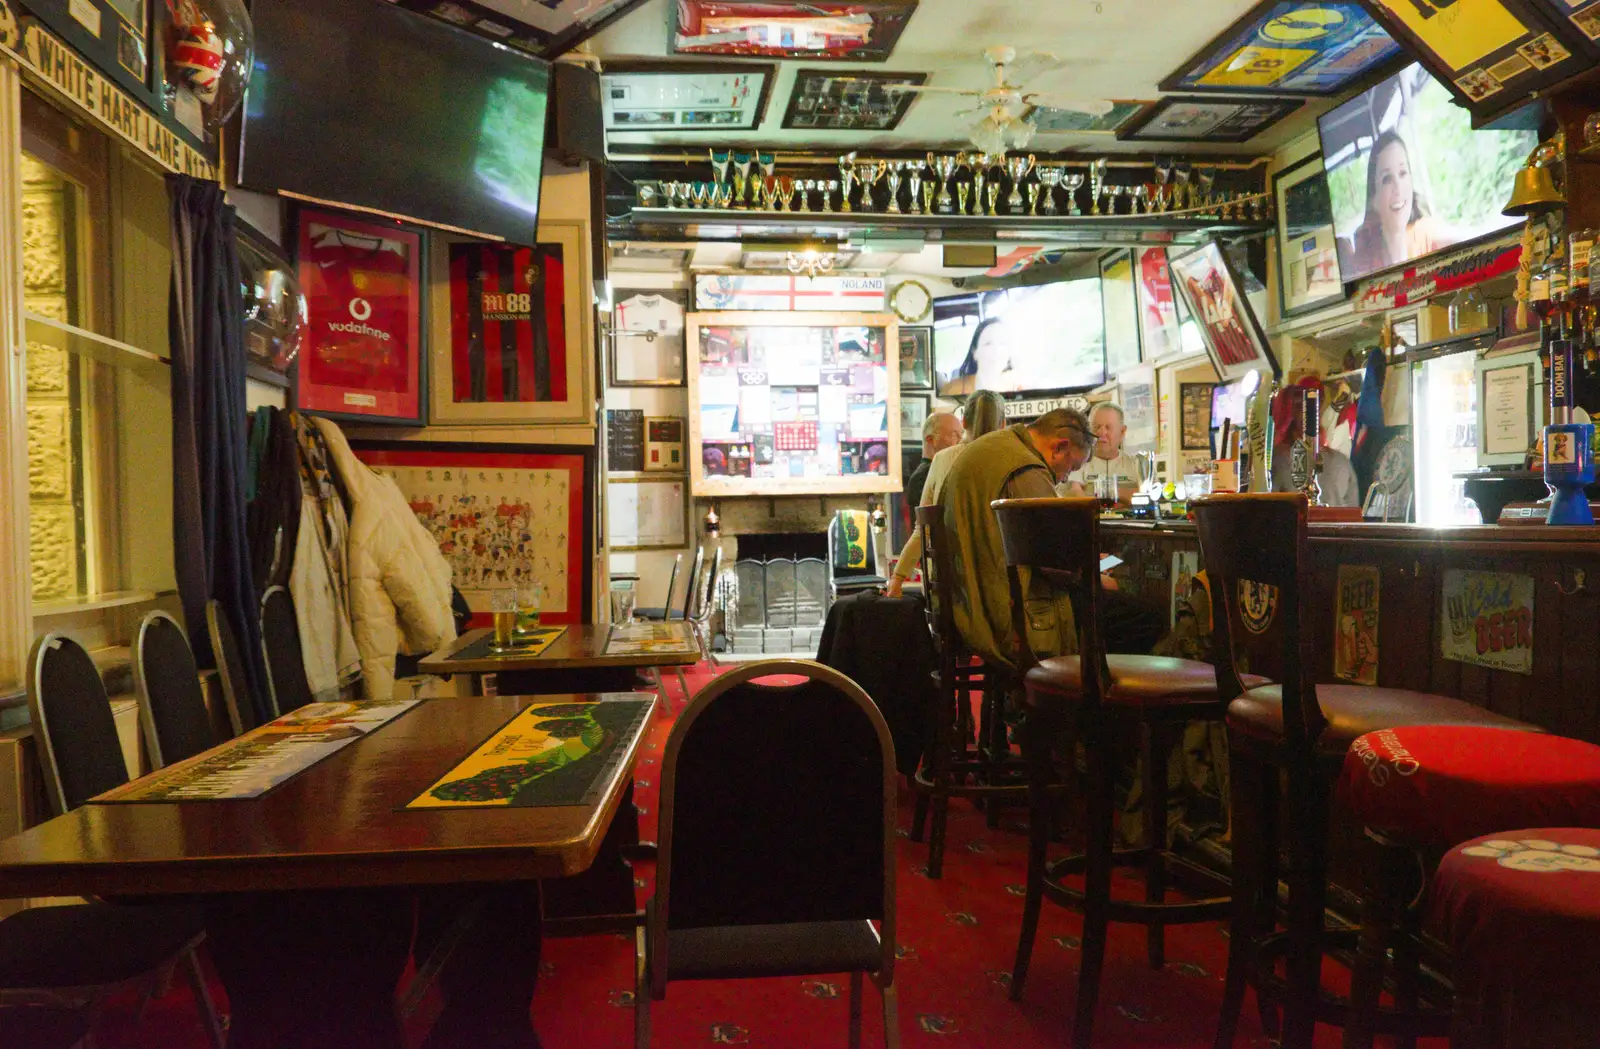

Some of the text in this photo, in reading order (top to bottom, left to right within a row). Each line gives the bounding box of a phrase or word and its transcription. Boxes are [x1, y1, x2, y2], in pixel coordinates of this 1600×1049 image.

[37, 30, 94, 109] WHITE
[100, 79, 140, 142] HART
[145, 115, 180, 171] LANE
[328, 321, 392, 341] vodafone
[1554, 353, 1565, 398] DOOM BAR
[1037, 401, 1062, 412] CITY
[1475, 607, 1533, 655] BEER
